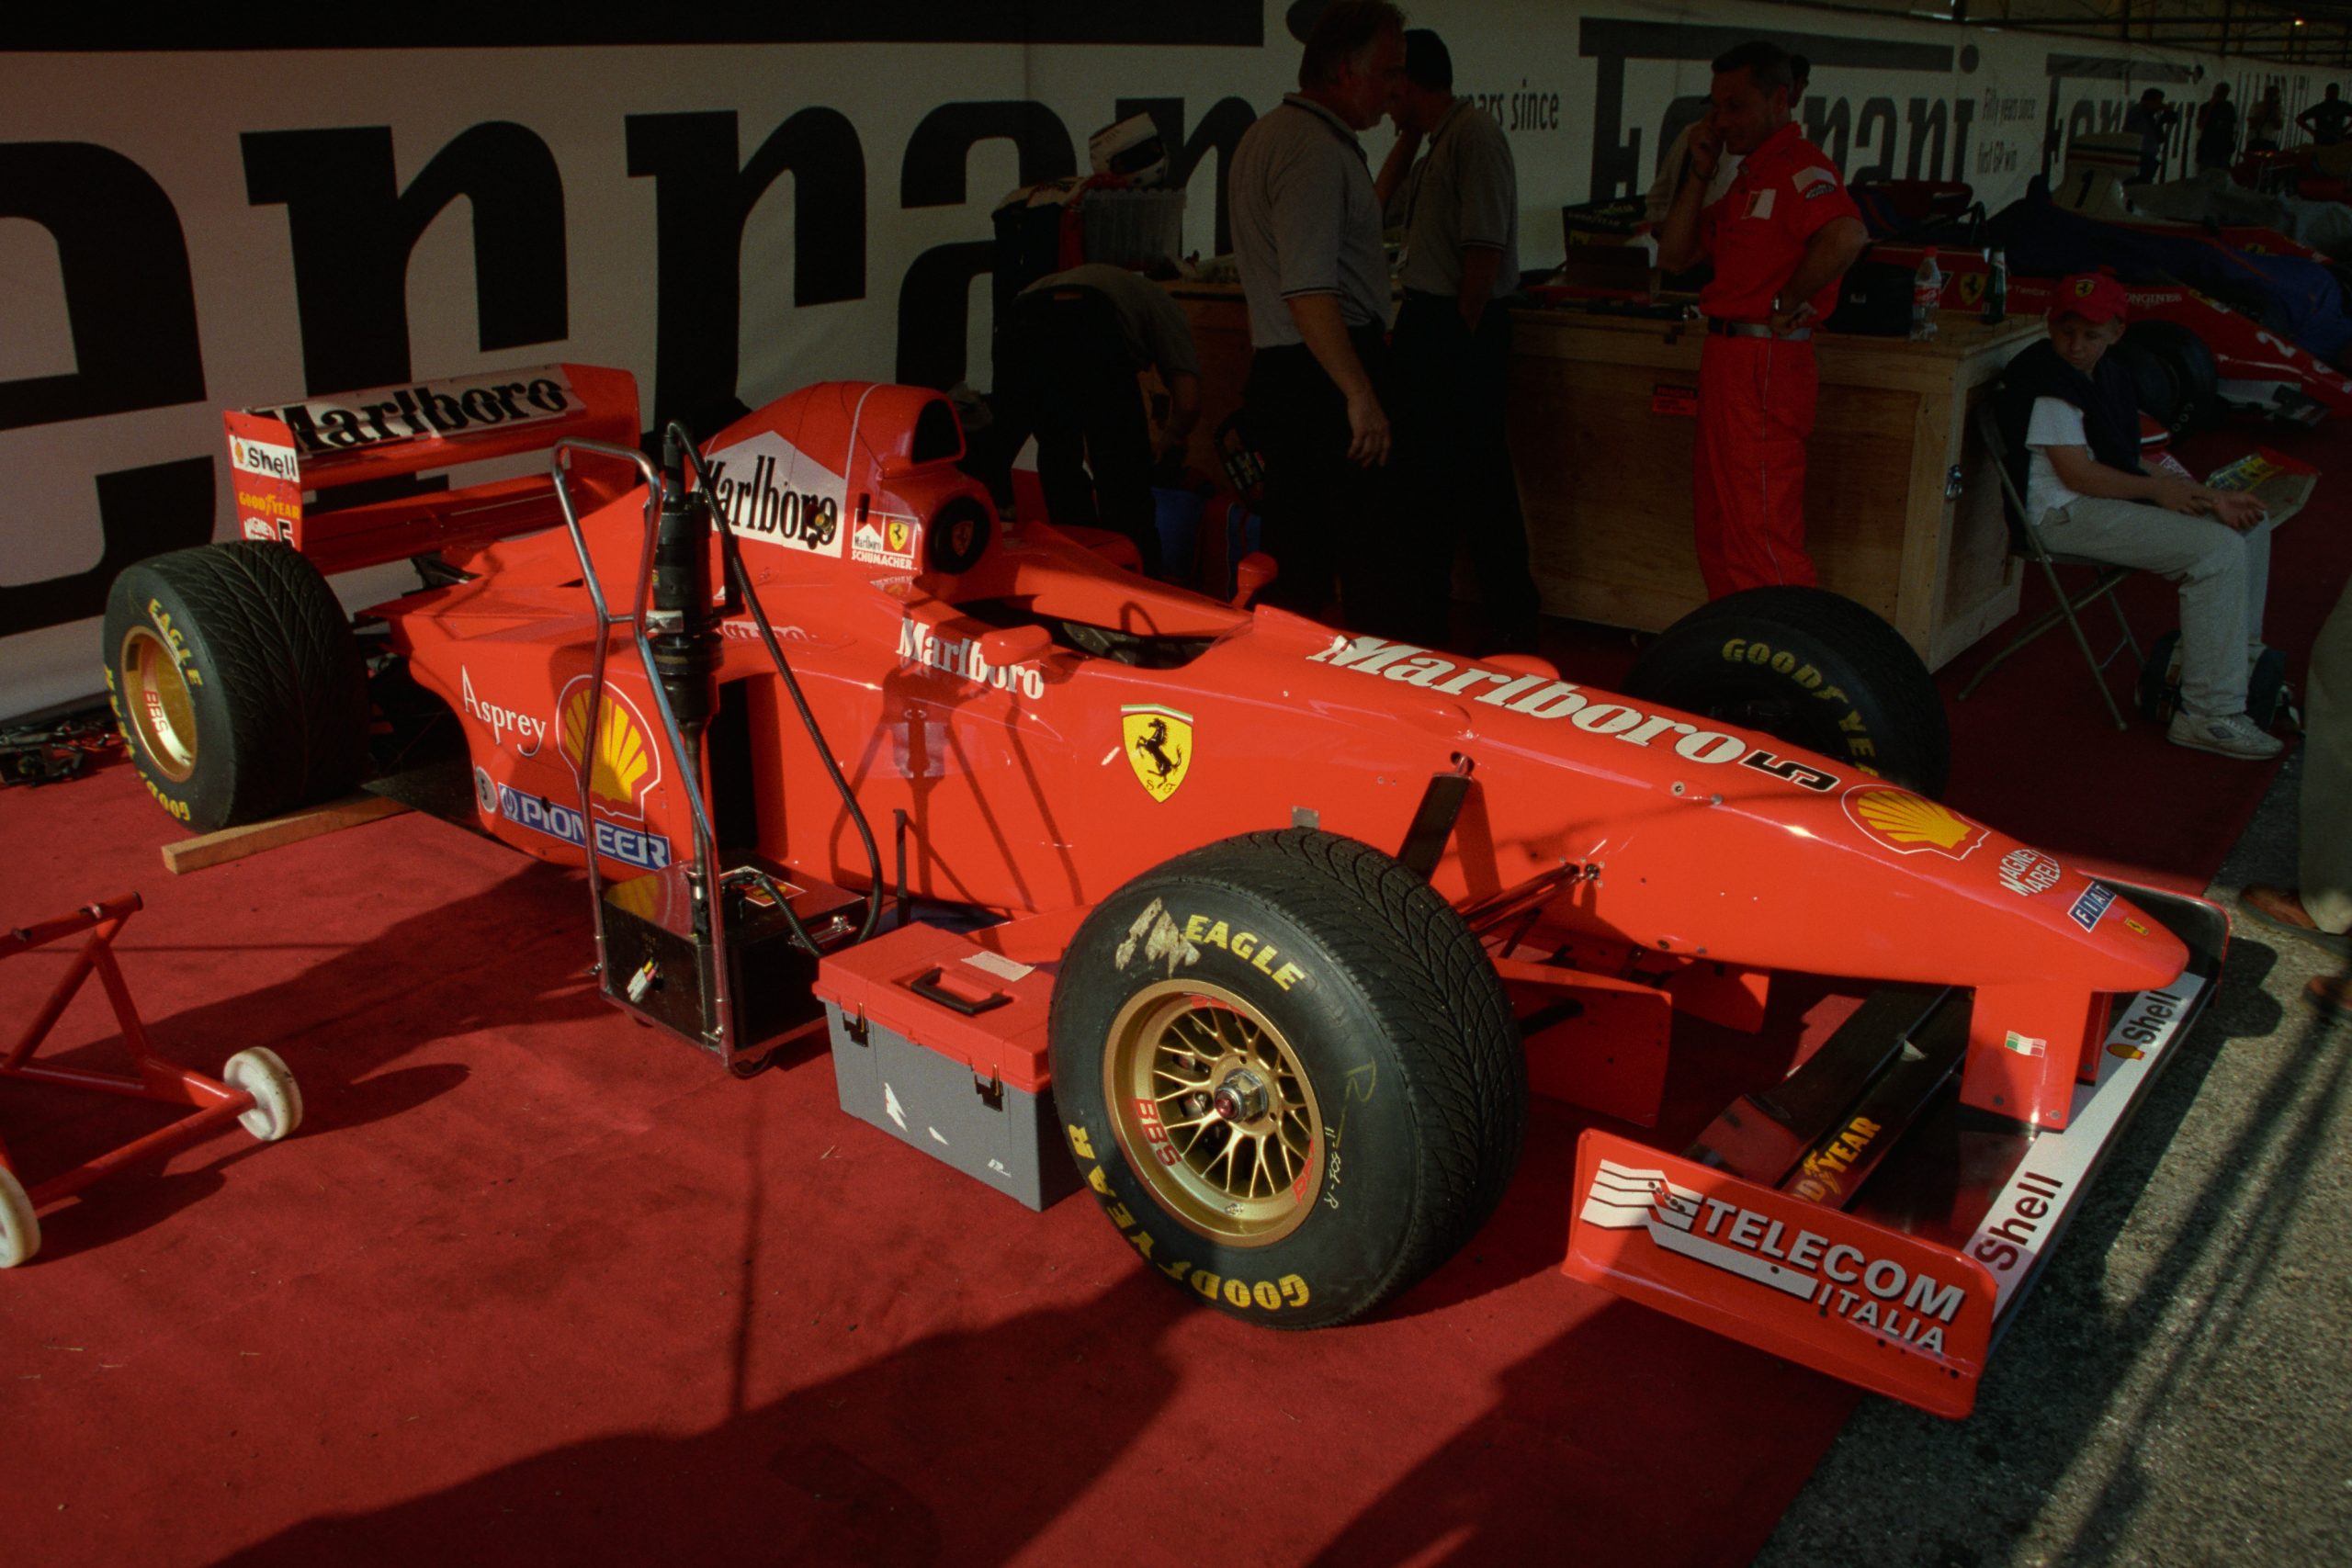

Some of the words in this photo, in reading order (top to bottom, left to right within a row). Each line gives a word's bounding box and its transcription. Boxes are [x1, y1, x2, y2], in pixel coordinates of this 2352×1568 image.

[1510, 78, 1560, 130] since
[2125, 292, 2183, 307] ONGINES
[248, 446, 296, 478] Shell
[238, 491, 300, 519] GOODYEAR
[851, 550, 912, 570] SCHUMACHER
[854, 536, 883, 550] Marlboro
[895, 617, 1045, 700] Marlboro
[143, 691, 169, 734] BBS
[461, 664, 547, 757] Asprey
[1306, 635, 1747, 765] Marlboro
[1721, 637, 1881, 779] GOODYE
[1737, 749, 1841, 793] 5
[522, 795, 668, 871] PIONEER
[2075, 884, 2112, 924] FIAT
[1183, 914, 1306, 991] EAGLE
[2121, 988, 2184, 1044] Shell
[1134, 1098, 1182, 1167] BBS
[1067, 1122, 1311, 1312] GOODYEAR
[1973, 1170, 2064, 1272] Shell
[1703, 1196, 1966, 1325] TELECOM
[1816, 1282, 1945, 1356] ITALIA
